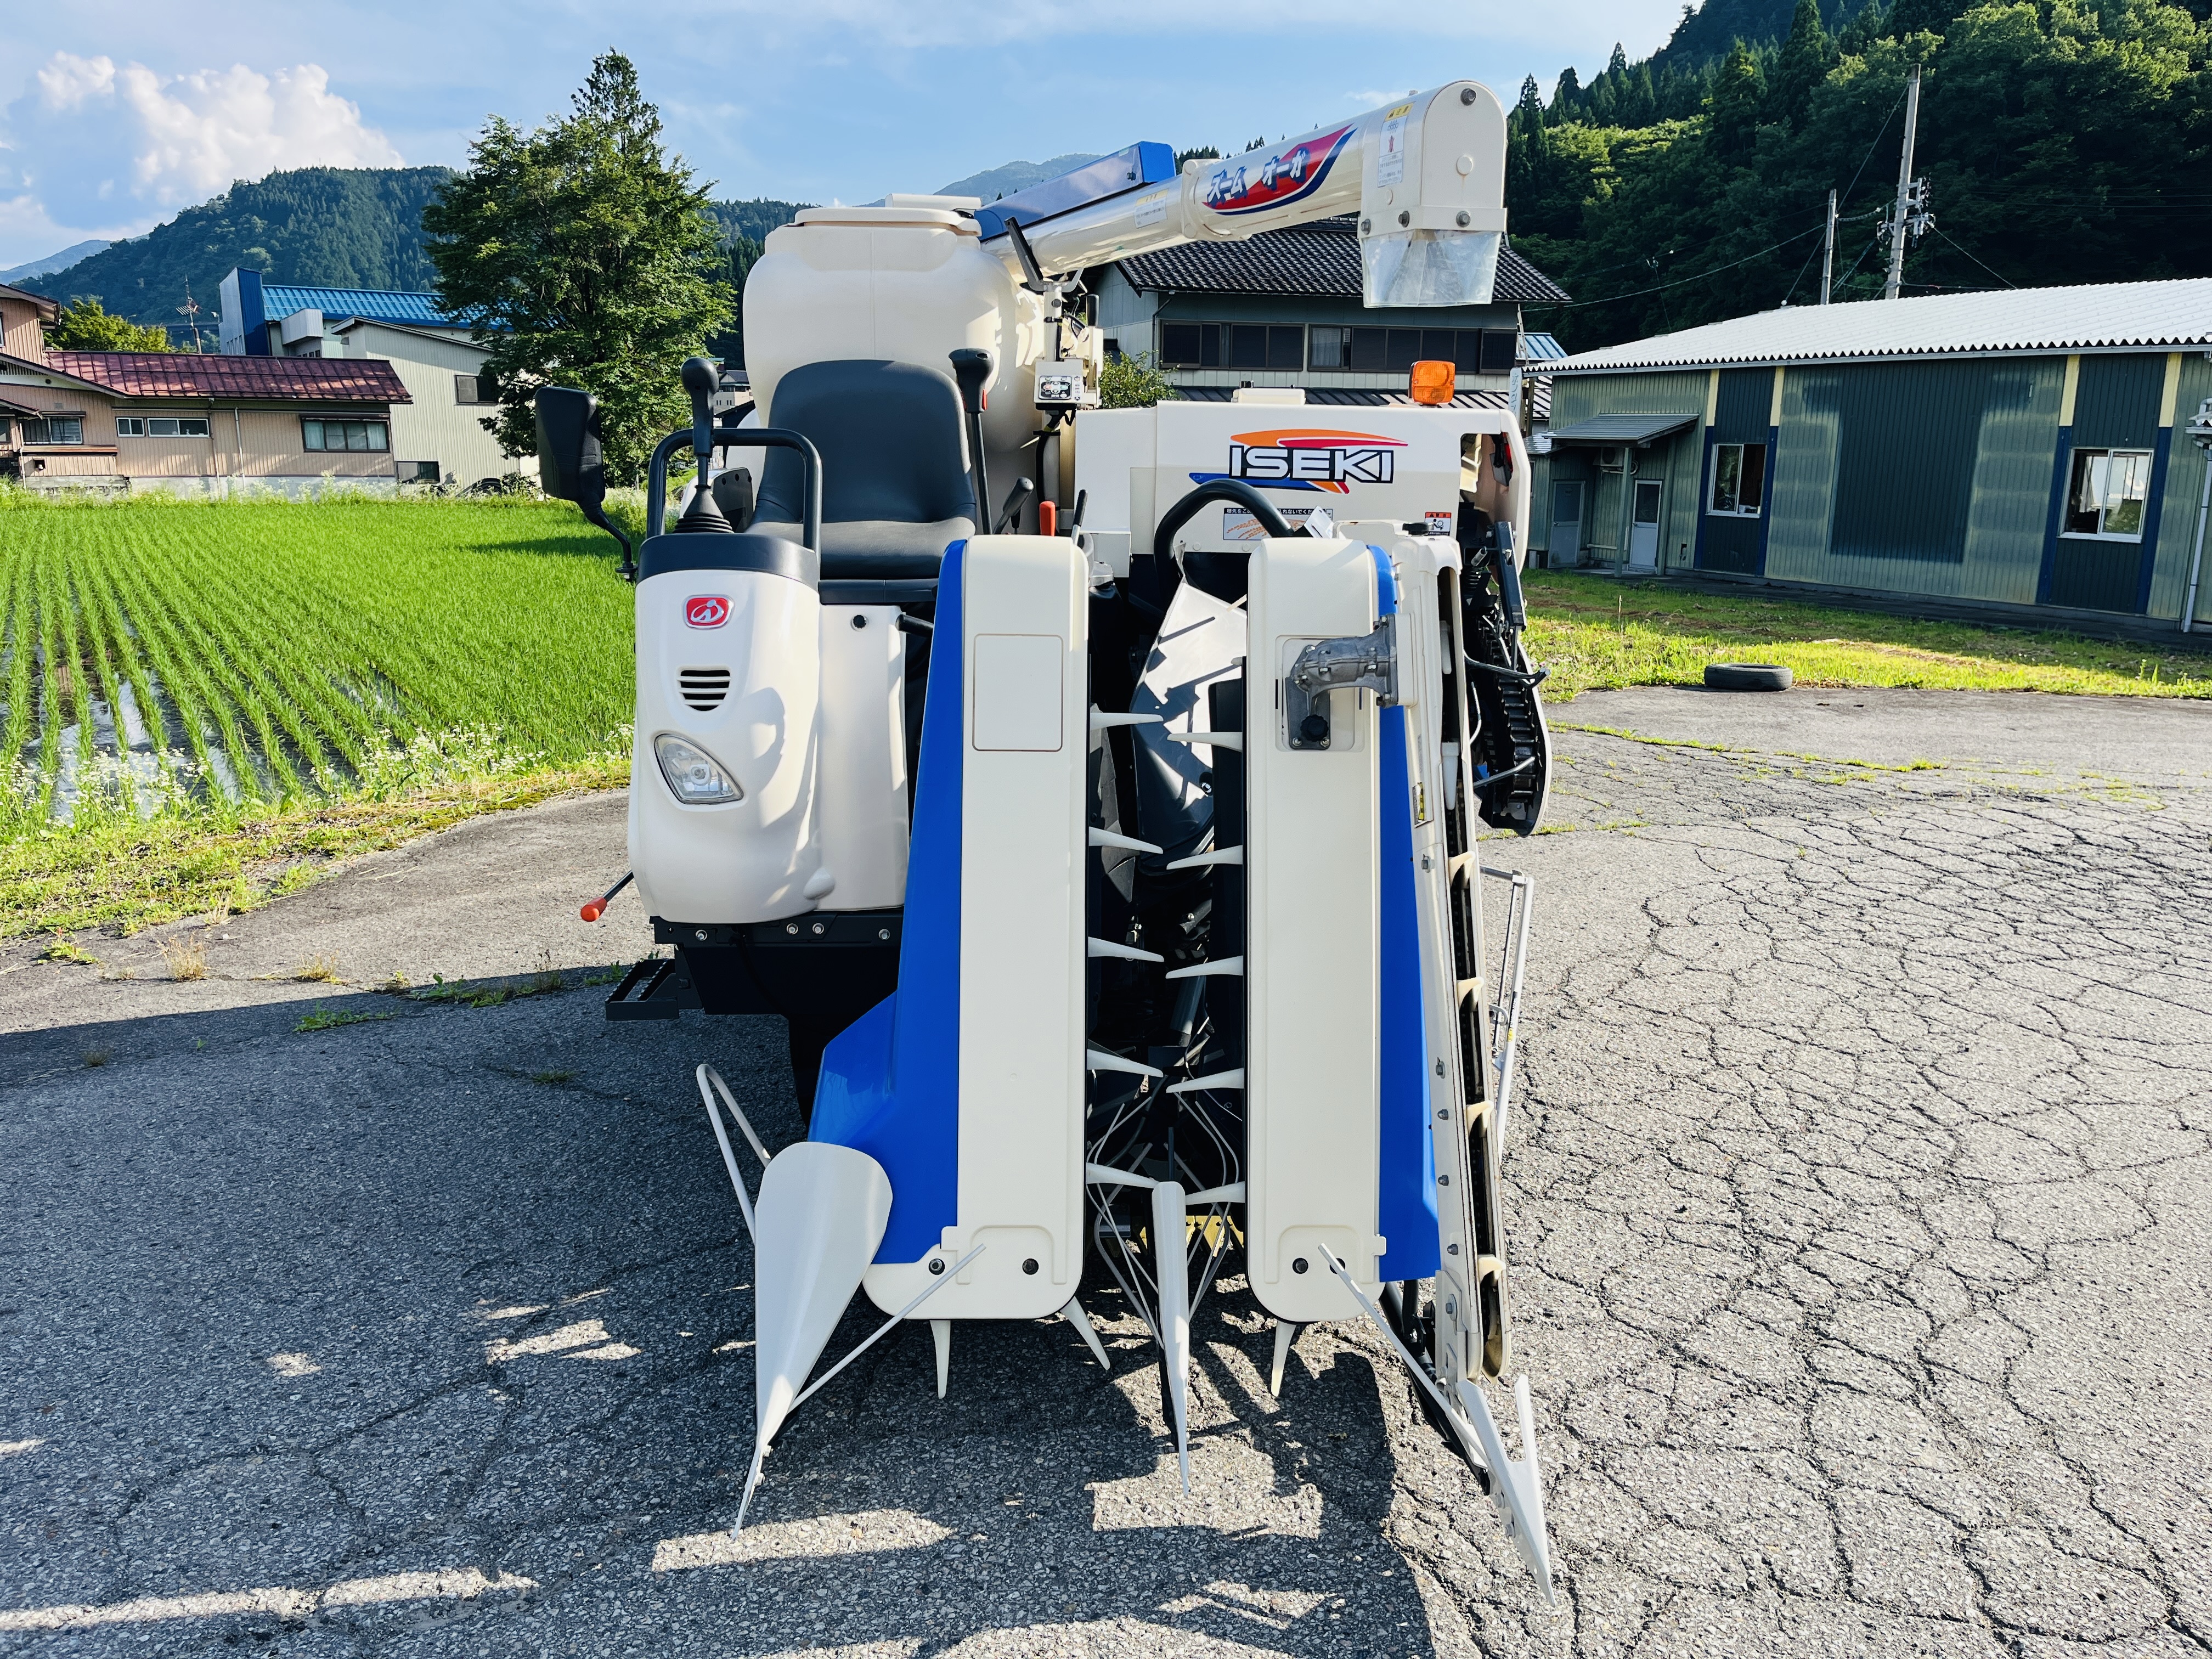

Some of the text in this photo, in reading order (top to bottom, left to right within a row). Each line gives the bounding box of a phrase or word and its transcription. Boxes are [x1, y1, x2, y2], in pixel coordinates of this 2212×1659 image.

[1207, 149, 1307, 204] ズーム オーガ
[1229, 445, 1393, 483] ISEKI
